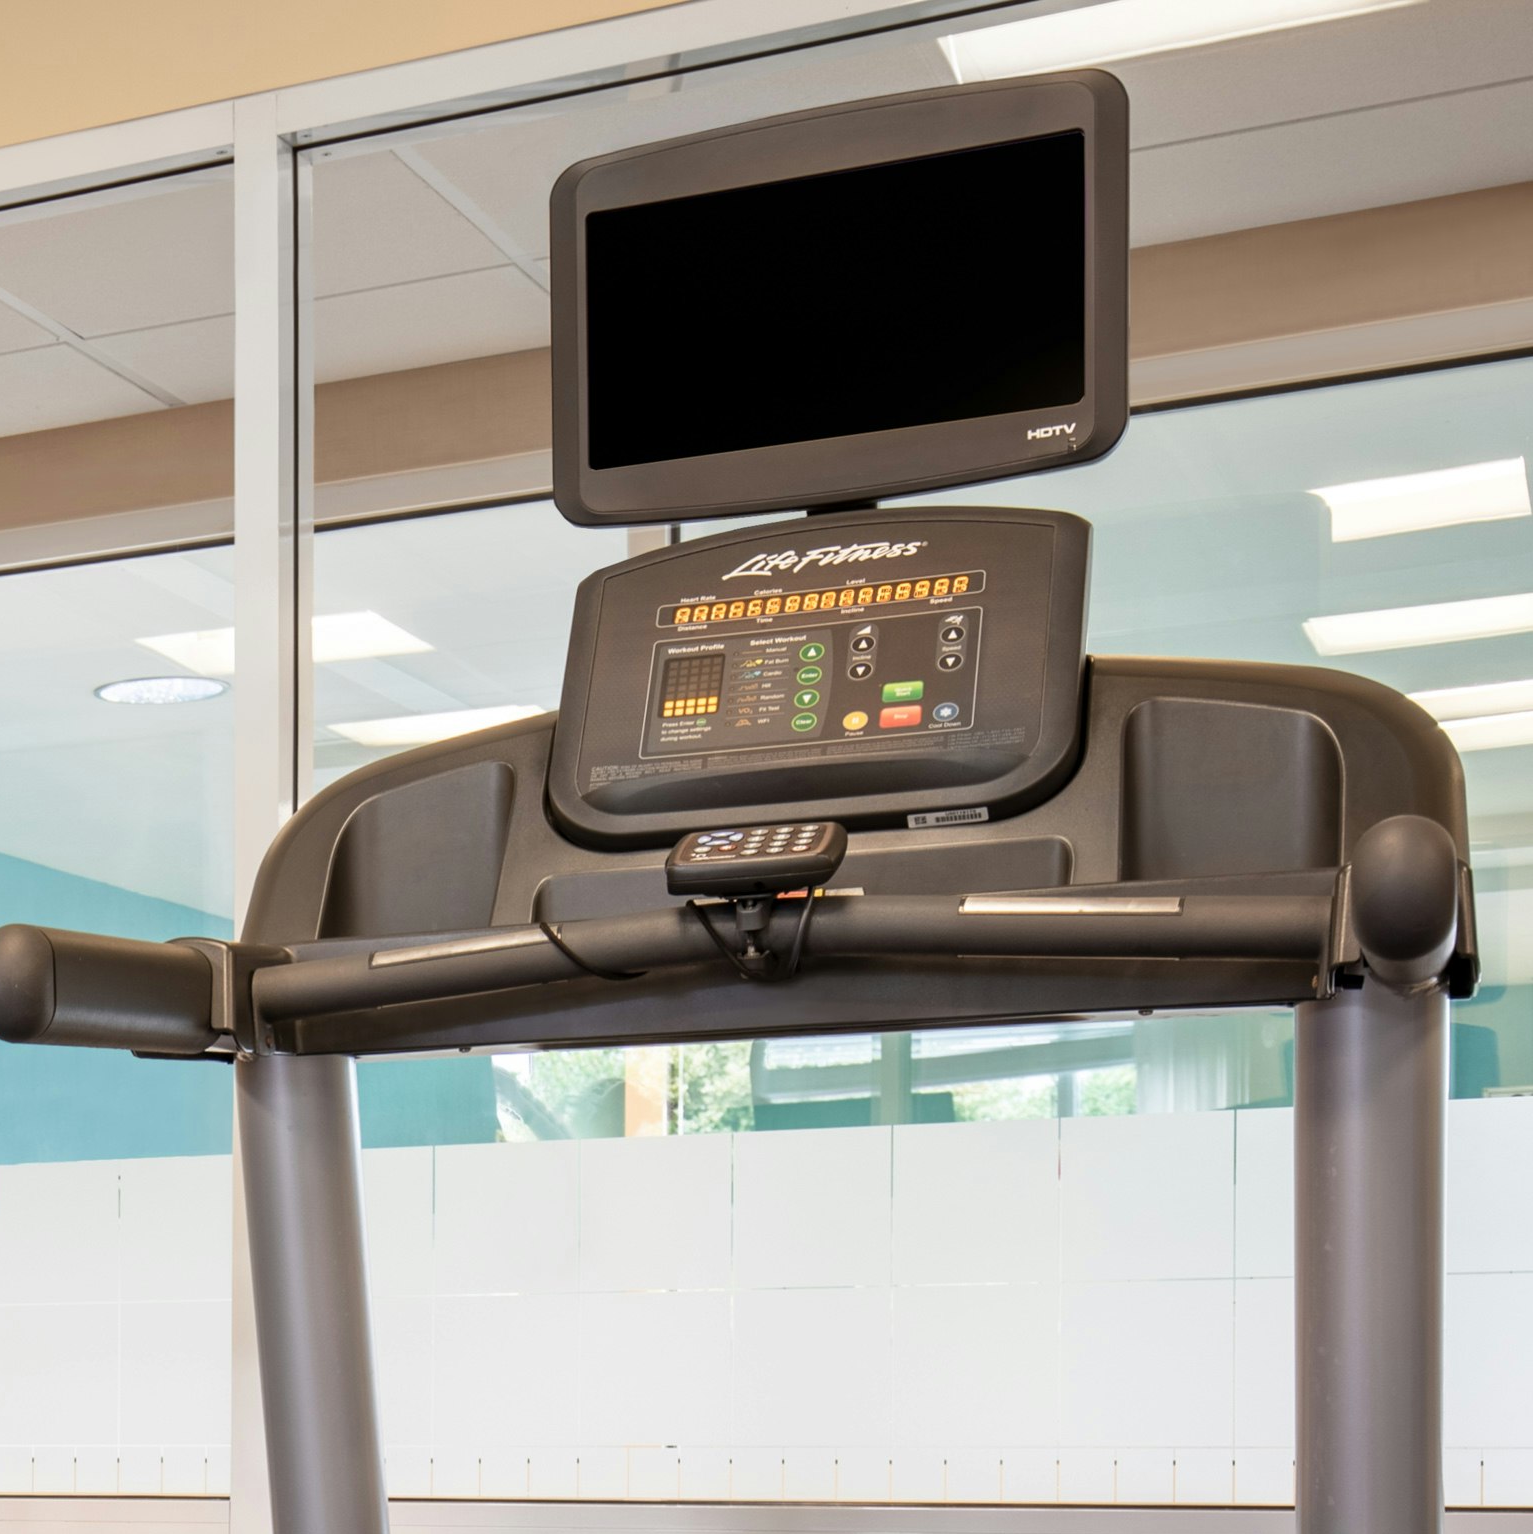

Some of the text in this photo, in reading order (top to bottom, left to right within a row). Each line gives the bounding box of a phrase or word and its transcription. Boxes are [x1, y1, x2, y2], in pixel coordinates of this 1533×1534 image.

[1027, 422, 1076, 440] HDTV
[846, 578, 866, 586] Level
[754, 587, 783, 596] Calories
[680, 594, 716, 604] Heart Rate
[929, 596, 953, 605] Speed
[840, 606, 865, 614] Incline
[756, 616, 773, 624] Time
[677, 624, 708, 632] Distance
[750, 635, 807, 647] Select Workout
[668, 643, 725, 655] Workout Profile
